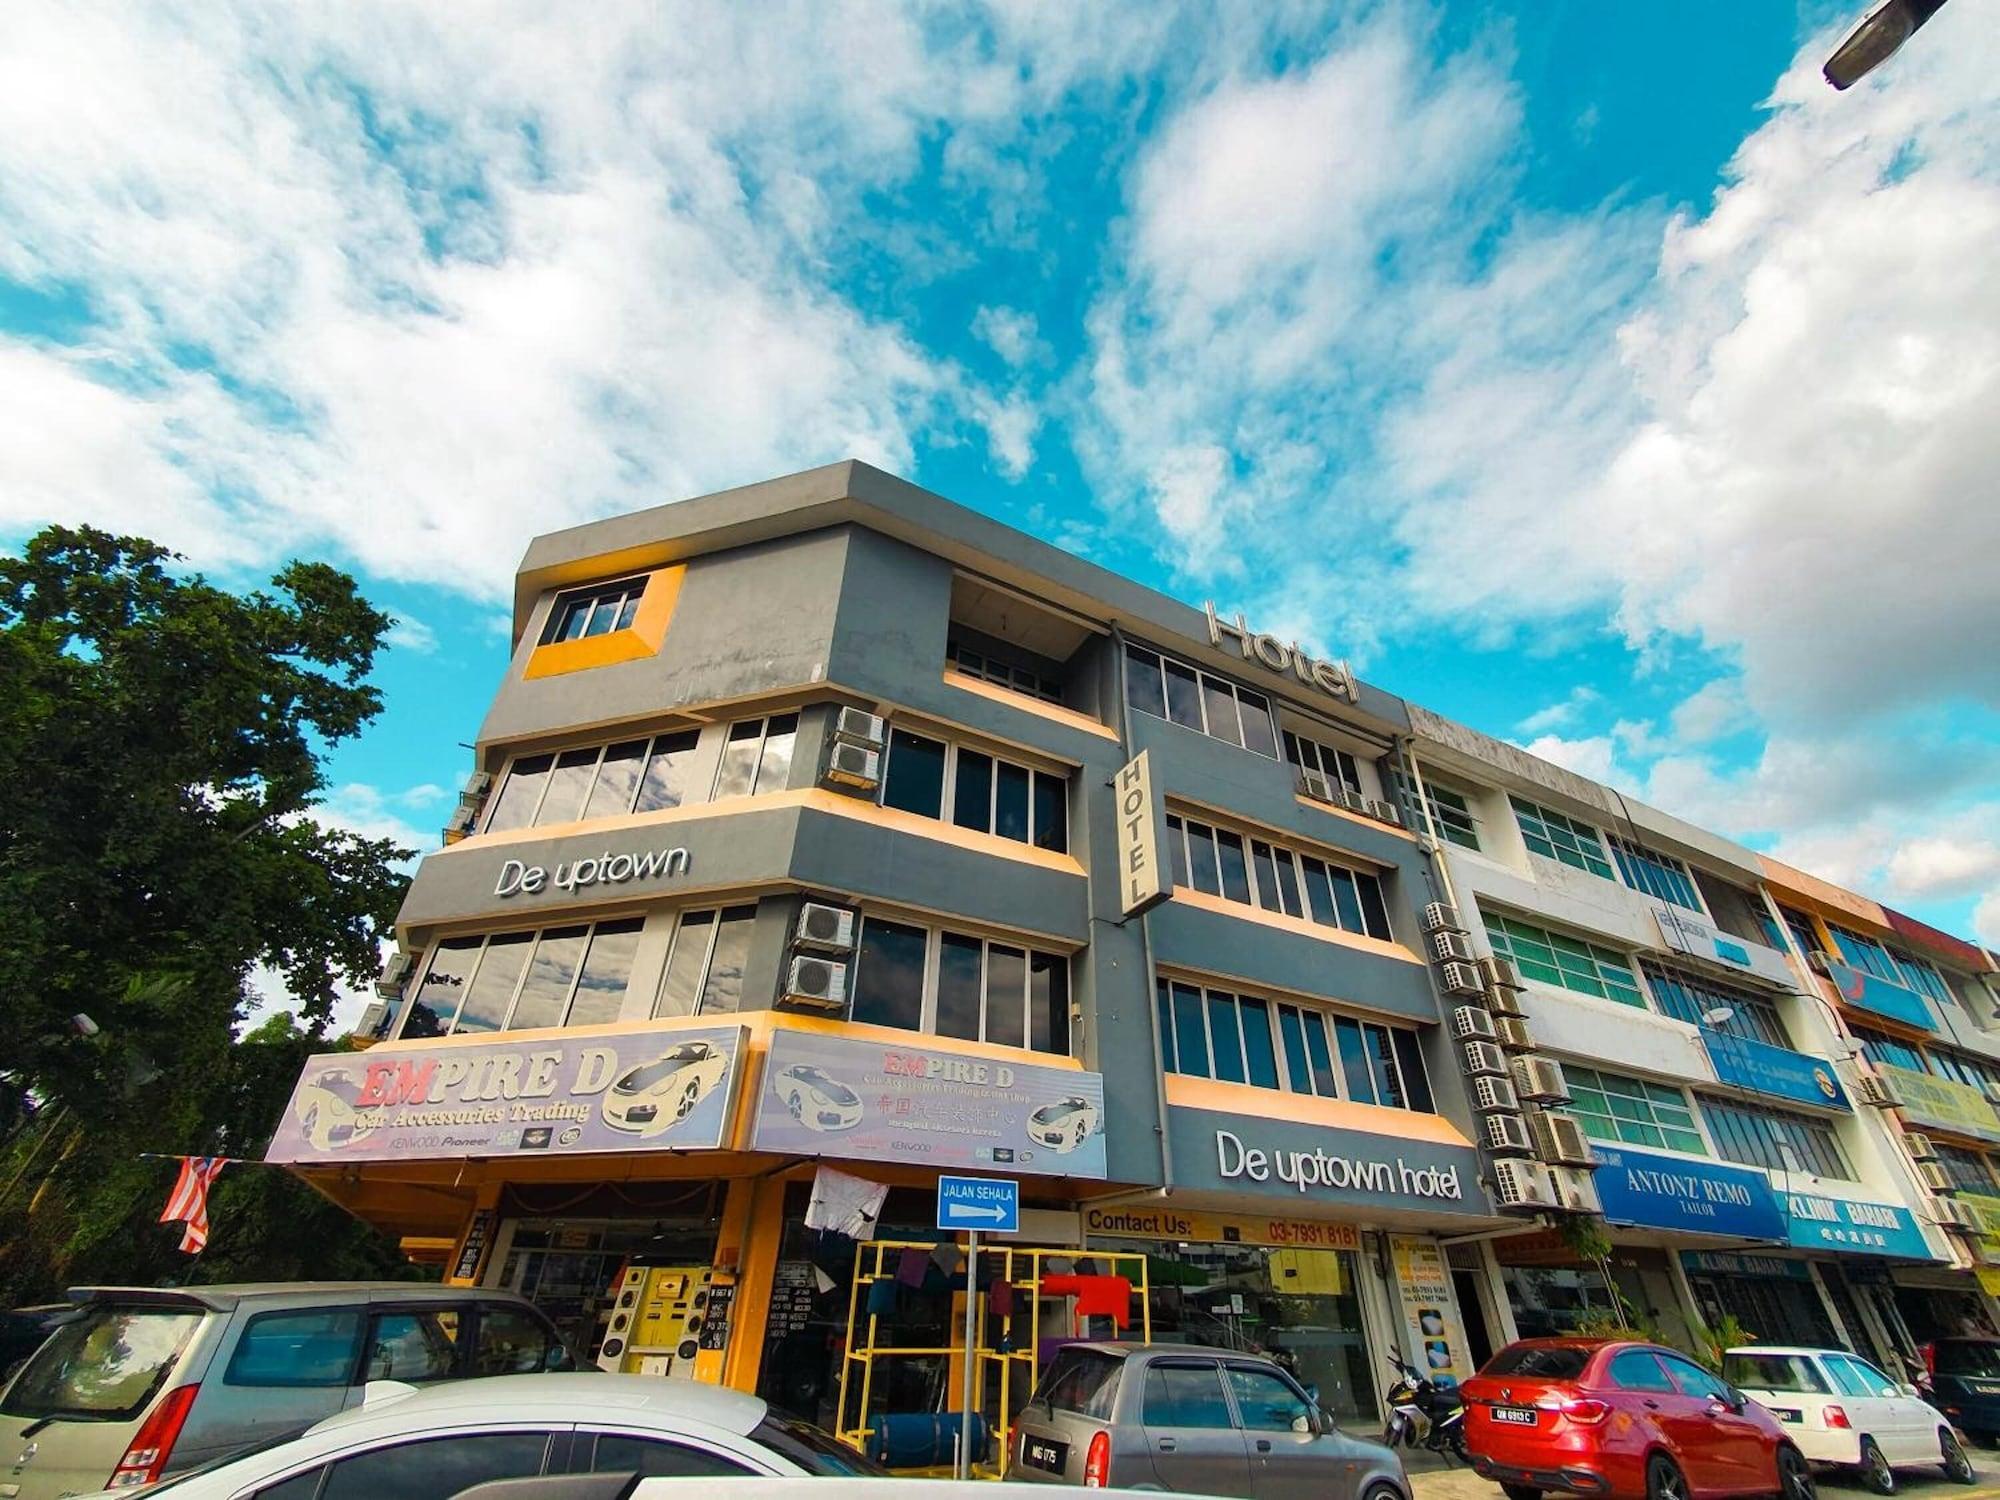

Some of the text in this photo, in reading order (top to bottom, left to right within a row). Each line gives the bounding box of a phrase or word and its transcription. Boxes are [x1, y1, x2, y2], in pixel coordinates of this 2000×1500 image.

[1205, 599, 1360, 704] Hotel
[1122, 759, 1147, 904] HOTEL
[494, 846, 690, 896] De uptown
[354, 1046, 618, 1108] EMPIRE D
[883, 1050, 1015, 1088] EMPIRE D
[354, 1099, 593, 1131] Car Accessories Trading
[440, 1136, 491, 1148] Pioneer
[1216, 1130, 1463, 1200] De uptown hotel
[943, 1184, 1014, 1201] JALAN SEHALA
[1678, 1200, 1717, 1217] TAILOR
[1701, 1178, 1752, 1207] REMO
[1789, 1196, 1842, 1223] KLINIK
[1088, 1208, 1359, 1246] Contact Us: 03-7931 8181
[1697, 1252, 1740, 1271] KLINIK
